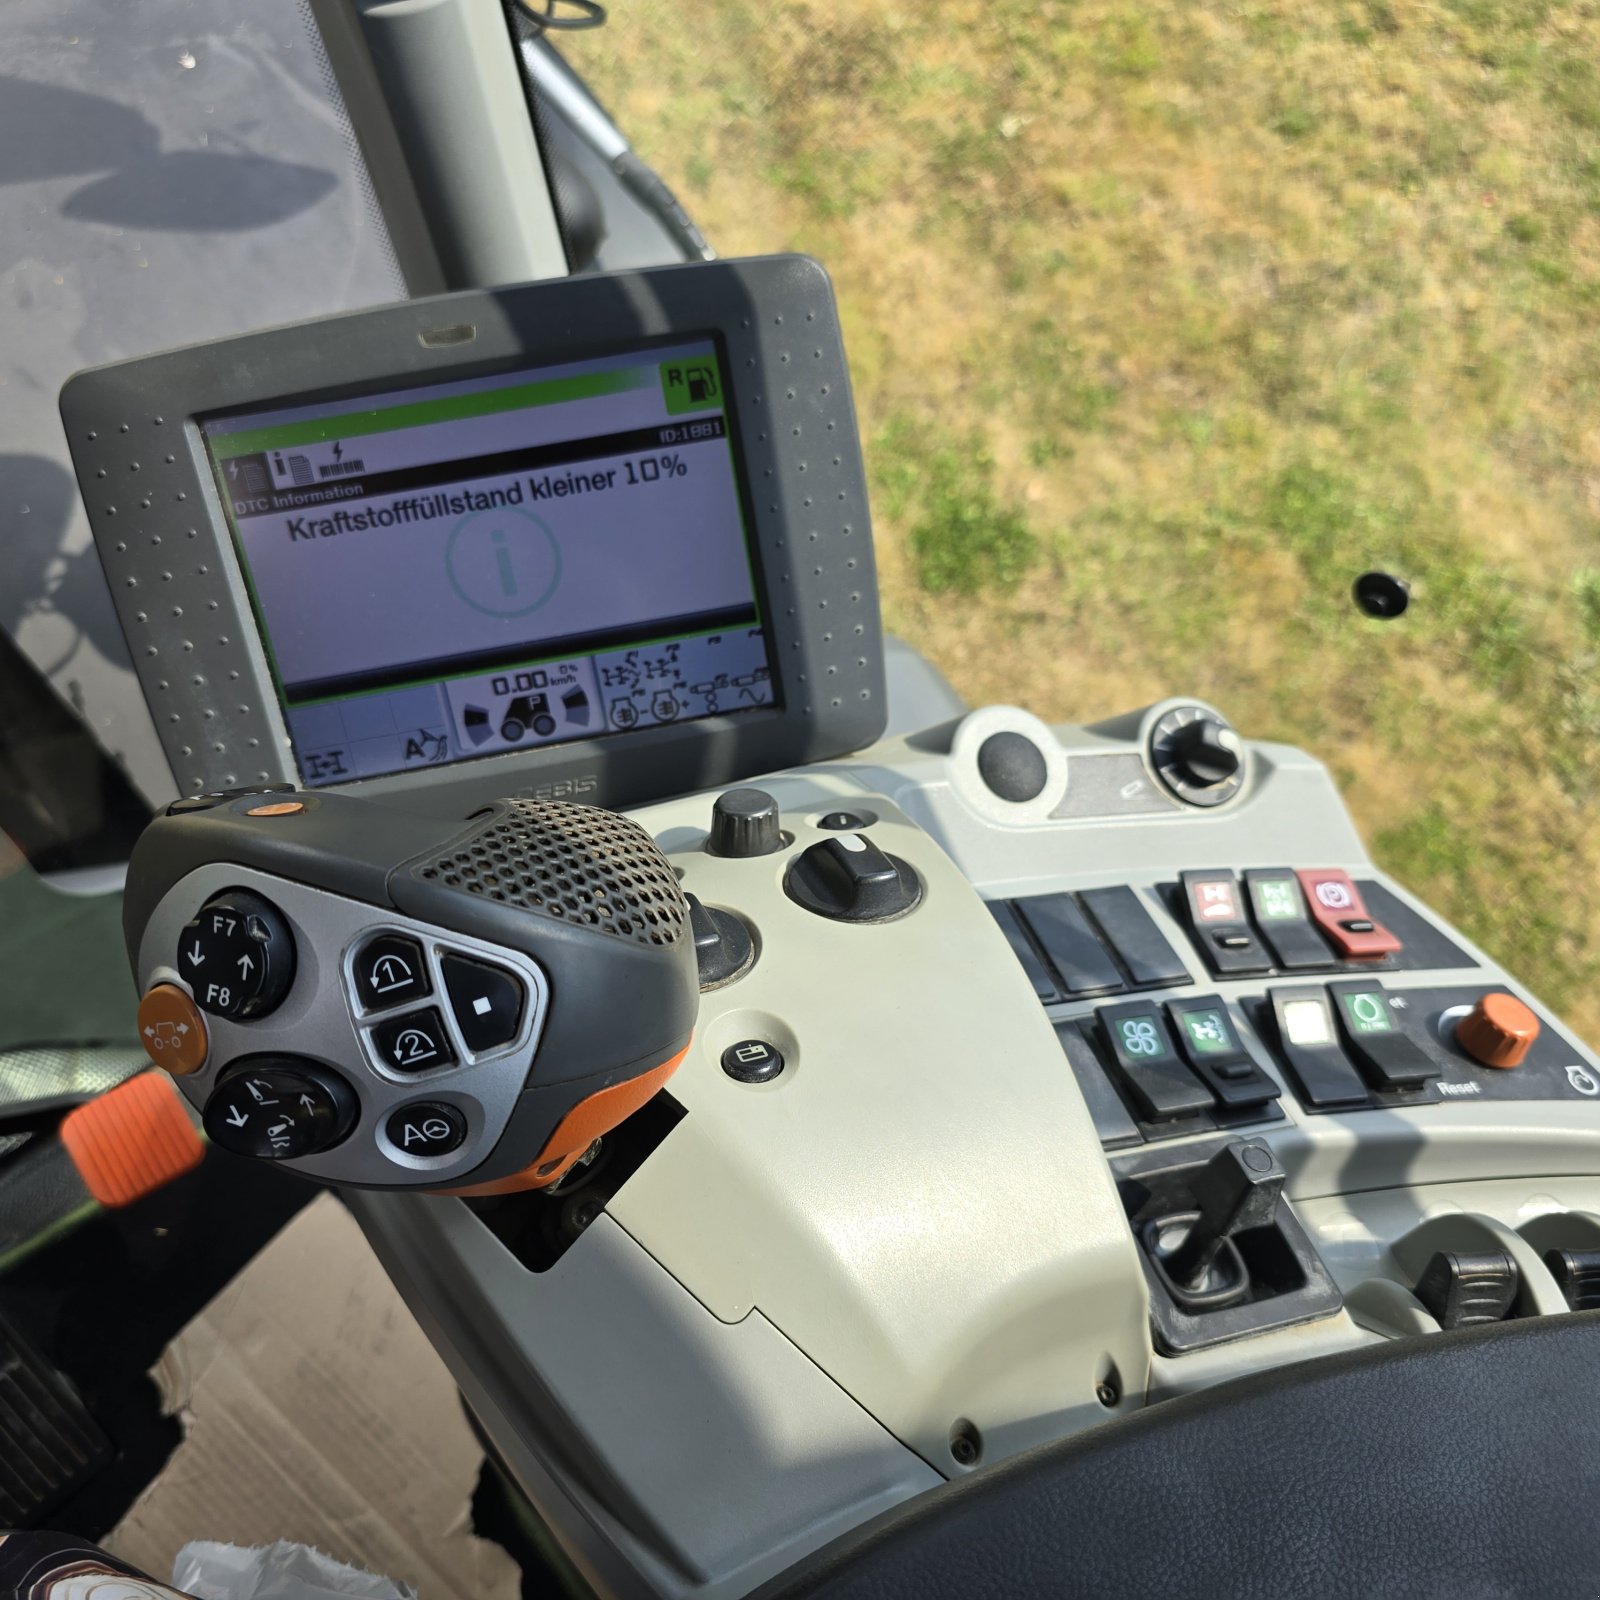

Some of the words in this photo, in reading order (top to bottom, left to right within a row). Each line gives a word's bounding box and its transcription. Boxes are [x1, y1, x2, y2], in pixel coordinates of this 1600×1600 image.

[667, 367, 683, 388] R
[233, 498, 270, 515] DTC
[272, 483, 365, 508] Information
[286, 480, 525, 543] Kraftstofffüllstand
[528, 466, 617, 503] kleiner
[624, 453, 688, 486] 10%
[491, 669, 549, 697] 0.00
[549, 673, 577, 687] km/h
[528, 695, 542, 712] P
[405, 737, 425, 760] A
[213, 914, 237, 937] F7
[382, 960, 396, 983] 1
[206, 983, 231, 1007] F8
[404, 1034, 424, 1057] 2
[1435, 1080, 1483, 1097] Reset
[404, 1123, 428, 1147] A
